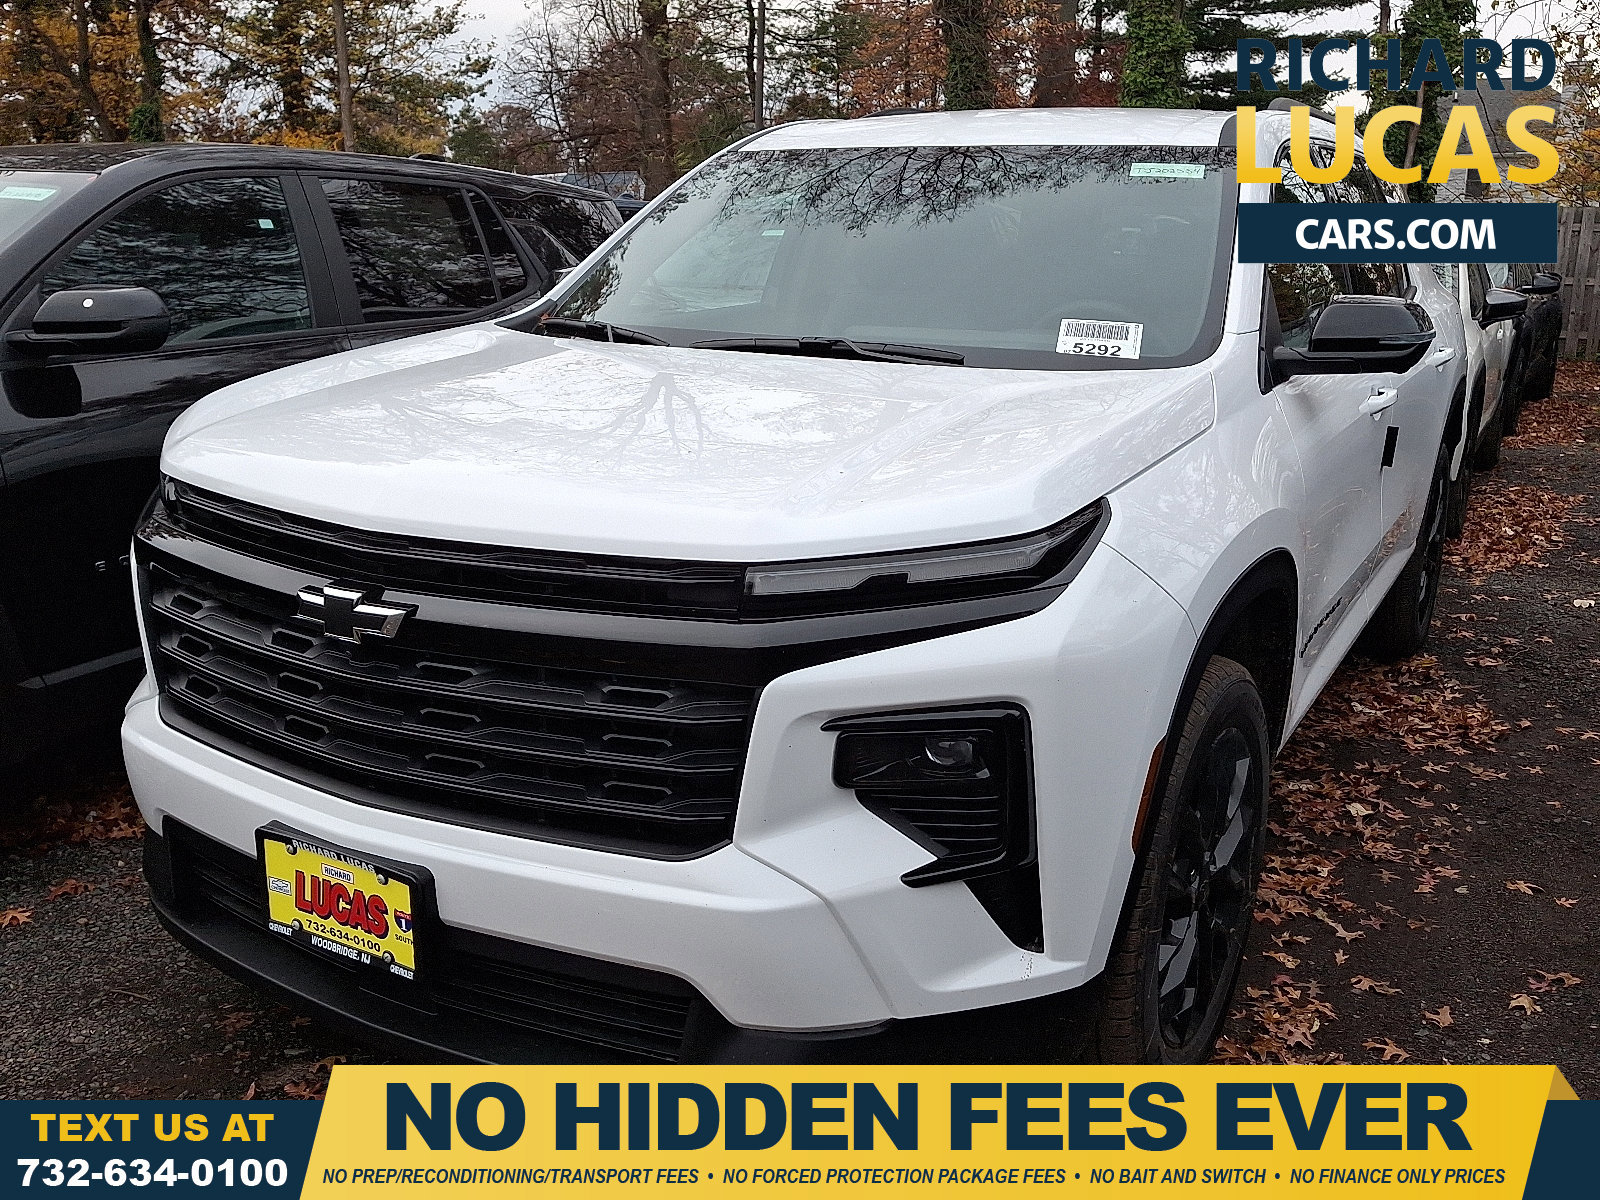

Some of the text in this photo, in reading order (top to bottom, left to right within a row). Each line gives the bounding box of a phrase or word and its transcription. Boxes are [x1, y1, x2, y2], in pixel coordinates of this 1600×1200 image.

[1072, 342, 1121, 356] 5292
[292, 839, 375, 873] RICHARD LUCAS
[324, 866, 351, 881] RICHARD
[295, 870, 389, 939] LUCAS
[305, 919, 381, 952] 732-634-0100
[399, 918, 408, 931] 1
[311, 934, 371, 964] WOODBRIDGE, NJ
